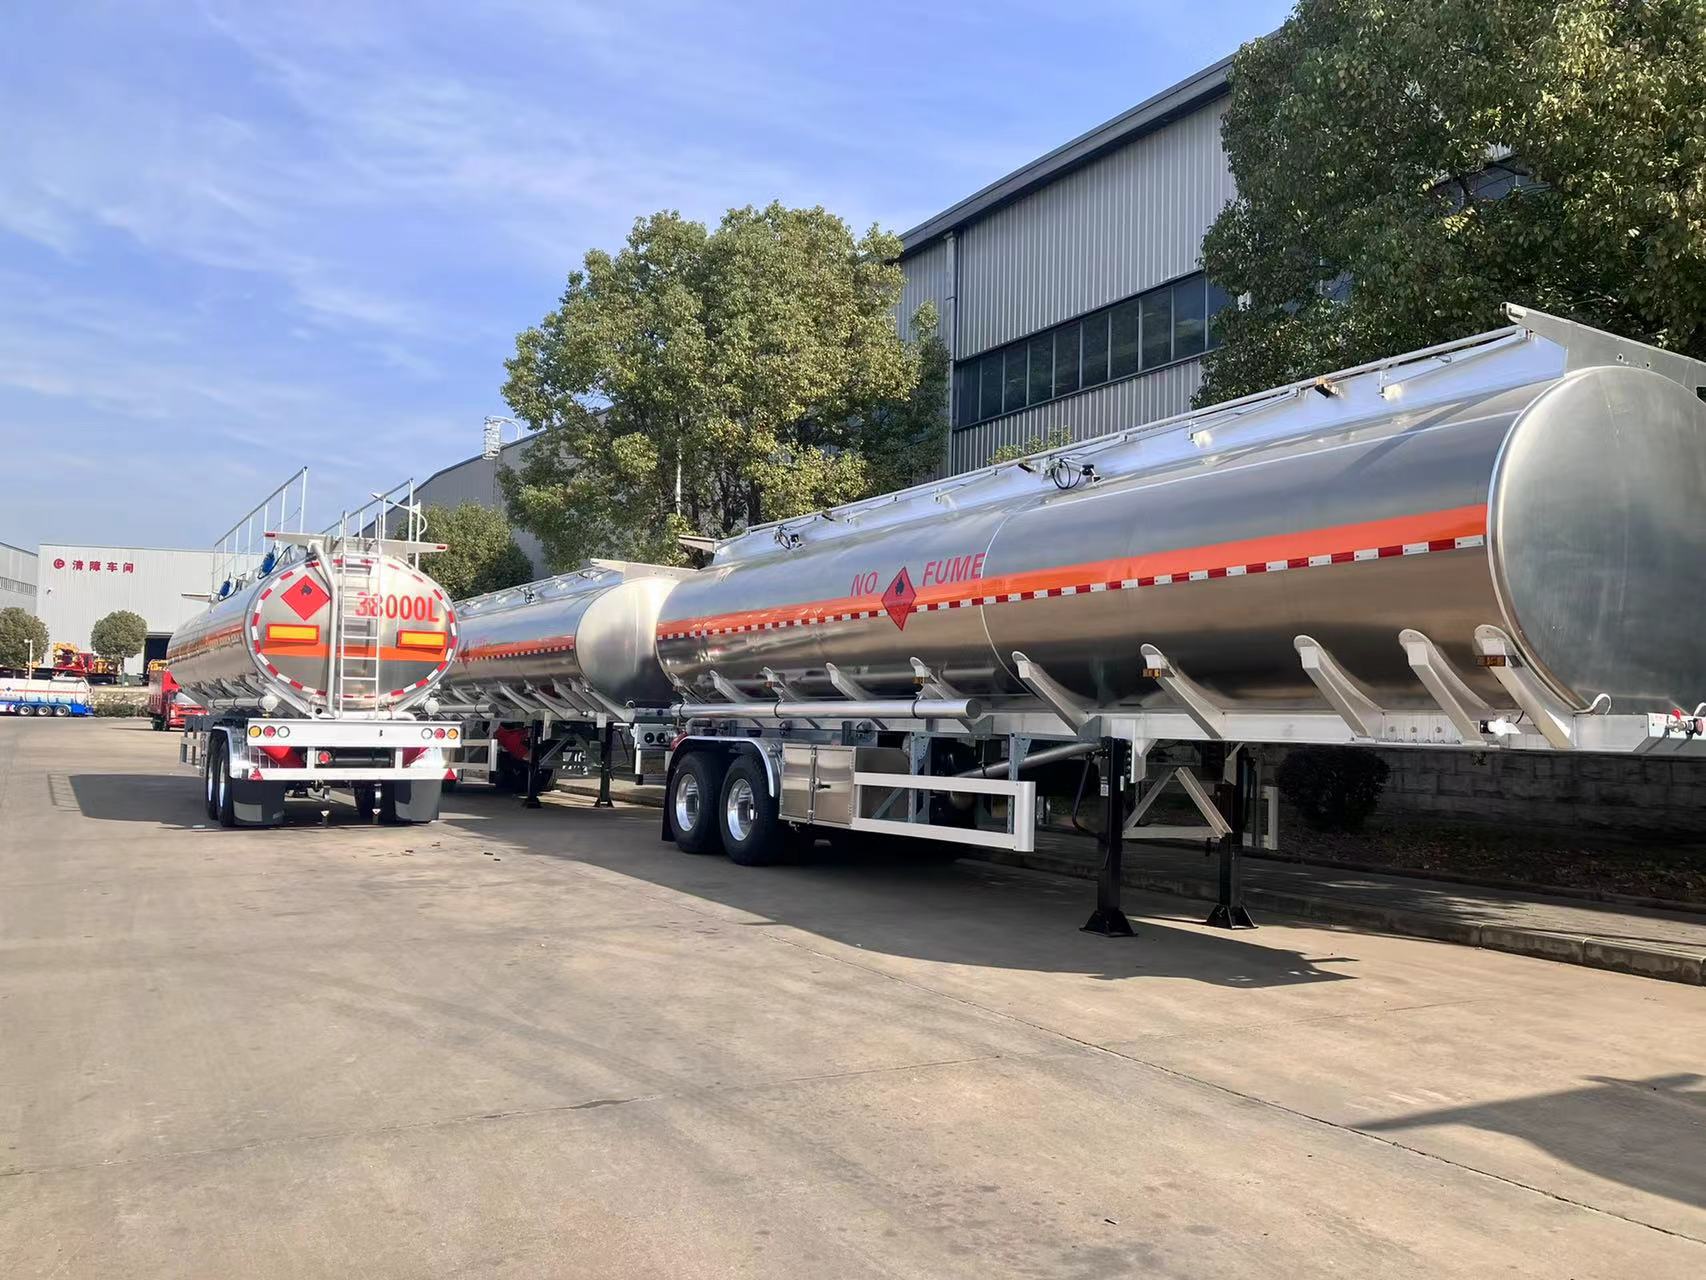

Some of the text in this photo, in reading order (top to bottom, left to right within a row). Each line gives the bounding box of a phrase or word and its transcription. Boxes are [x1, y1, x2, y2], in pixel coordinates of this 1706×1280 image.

[72, 559, 134, 574] 清障车间
[850, 552, 986, 597] NO FUME
[355, 591, 440, 623] 38000L
